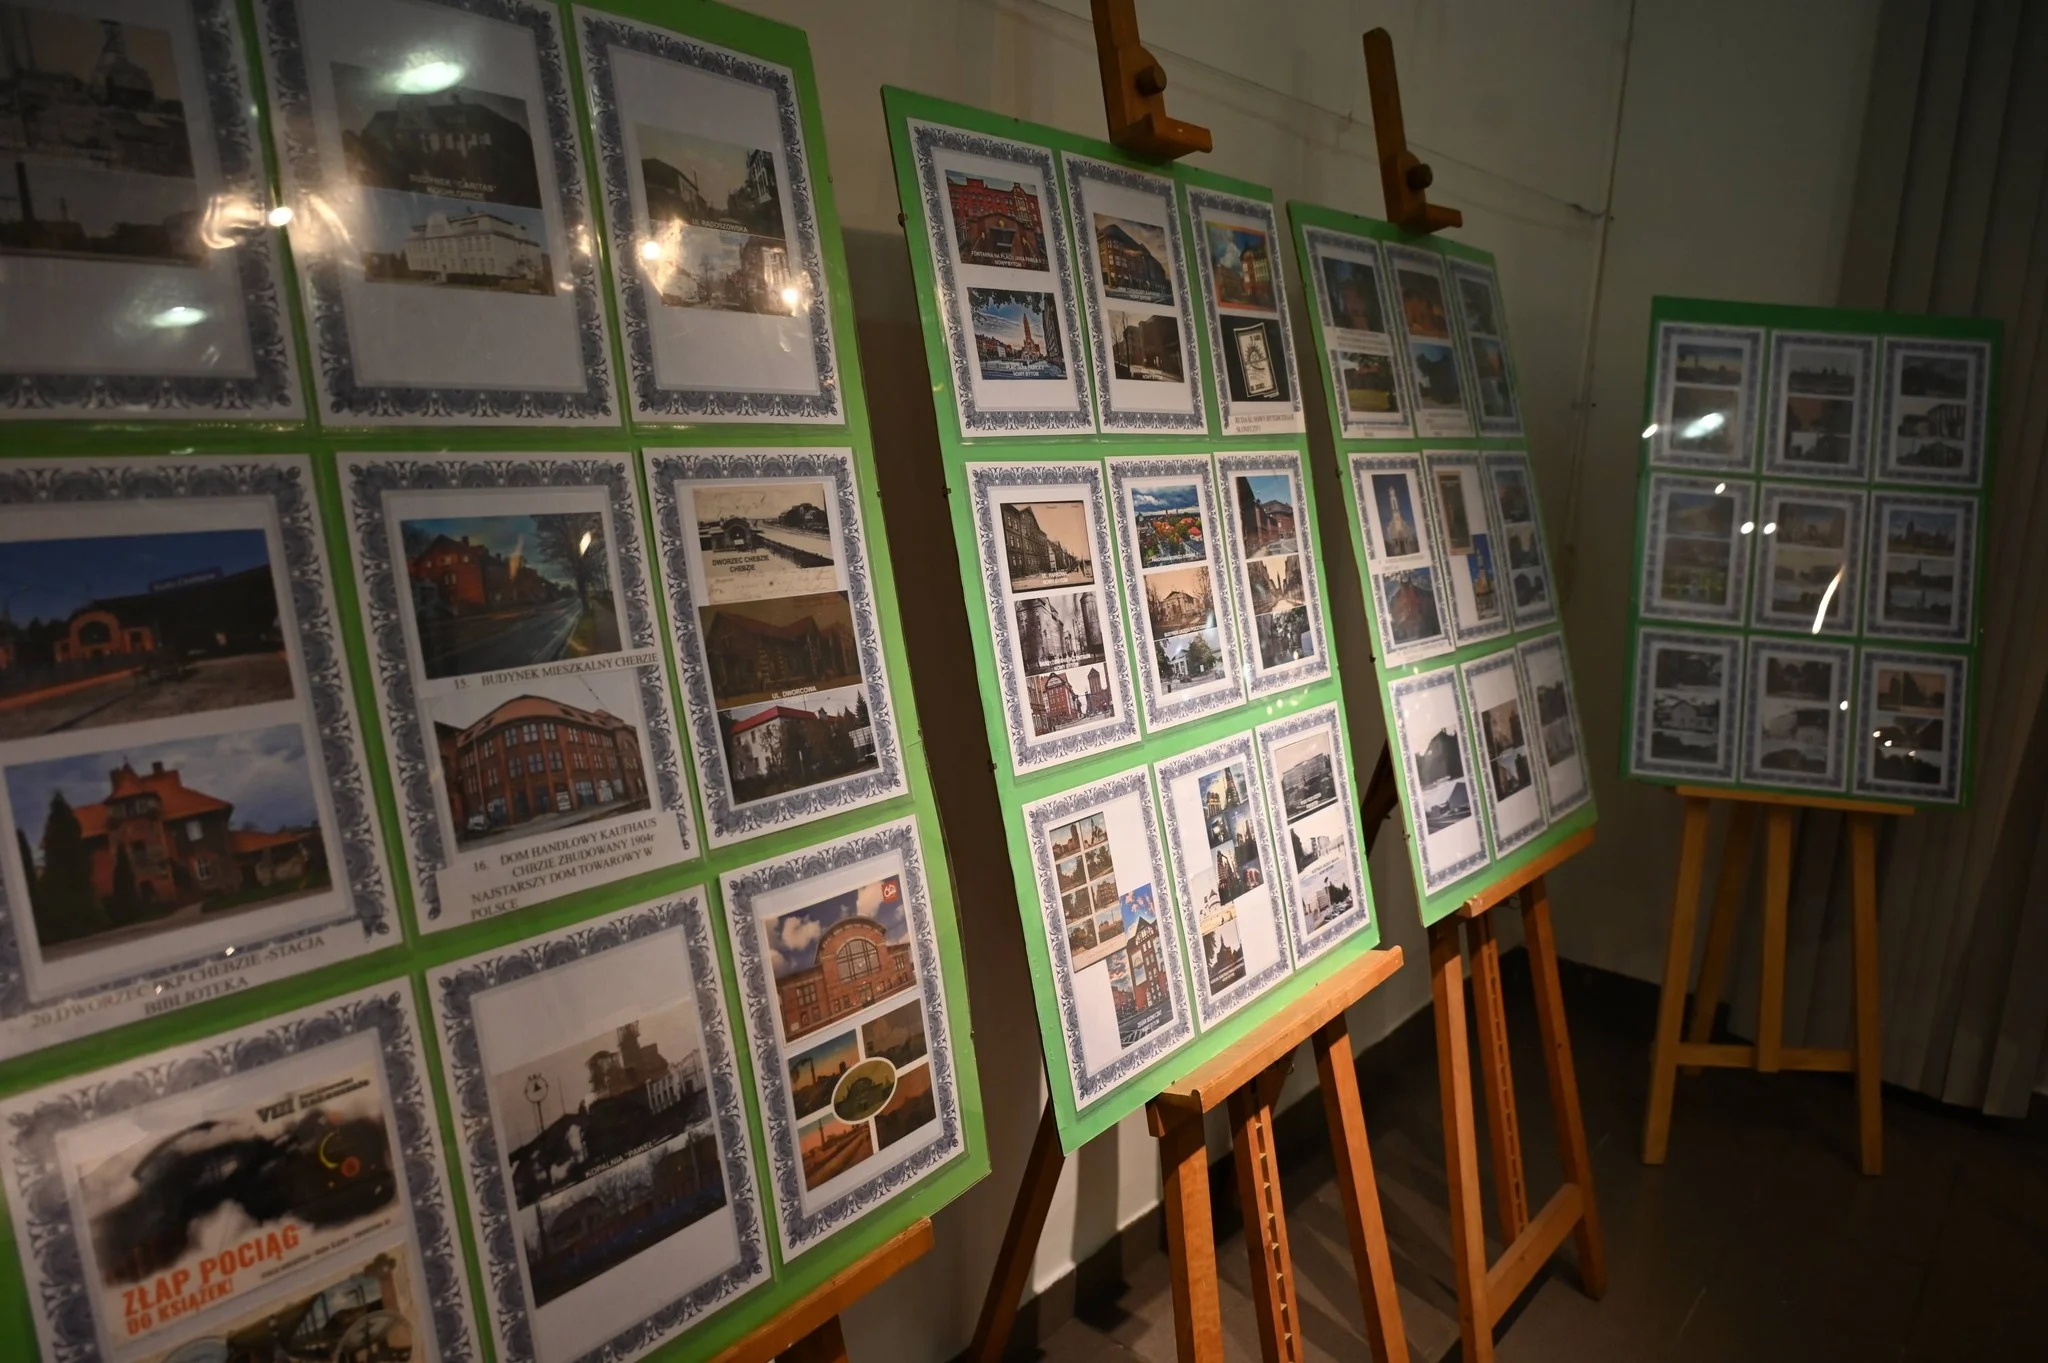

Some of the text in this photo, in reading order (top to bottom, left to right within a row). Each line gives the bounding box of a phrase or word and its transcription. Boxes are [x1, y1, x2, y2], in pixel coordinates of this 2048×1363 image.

[712, 554, 770, 567] DWORZEC CHEBZIE
[729, 564, 756, 573] CHEBZIE
[454, 652, 659, 690] 15. BUDYNEK MIESZKALNY CHEBZIE
[782, 686, 817, 698] DWORCOWA
[473, 817, 657, 873] 16. DOM HANDLOWY KAUFHAUS
[512, 833, 655, 878] CHBZIE ZBUDOWANY 1904r
[471, 846, 653, 904] NAJSTARSZY DOM TOWAROWY W
[470, 898, 518, 920] POLSCE
[187, 953, 262, 985] CHEBZIE
[143, 976, 248, 1016] BIBLIOTEKA
[585, 1155, 624, 1178] KOPALNIA
[121, 1268, 191, 1318] ZŁAP
[198, 1224, 301, 1286] POCIĄG
[126, 1309, 154, 1337] DO
